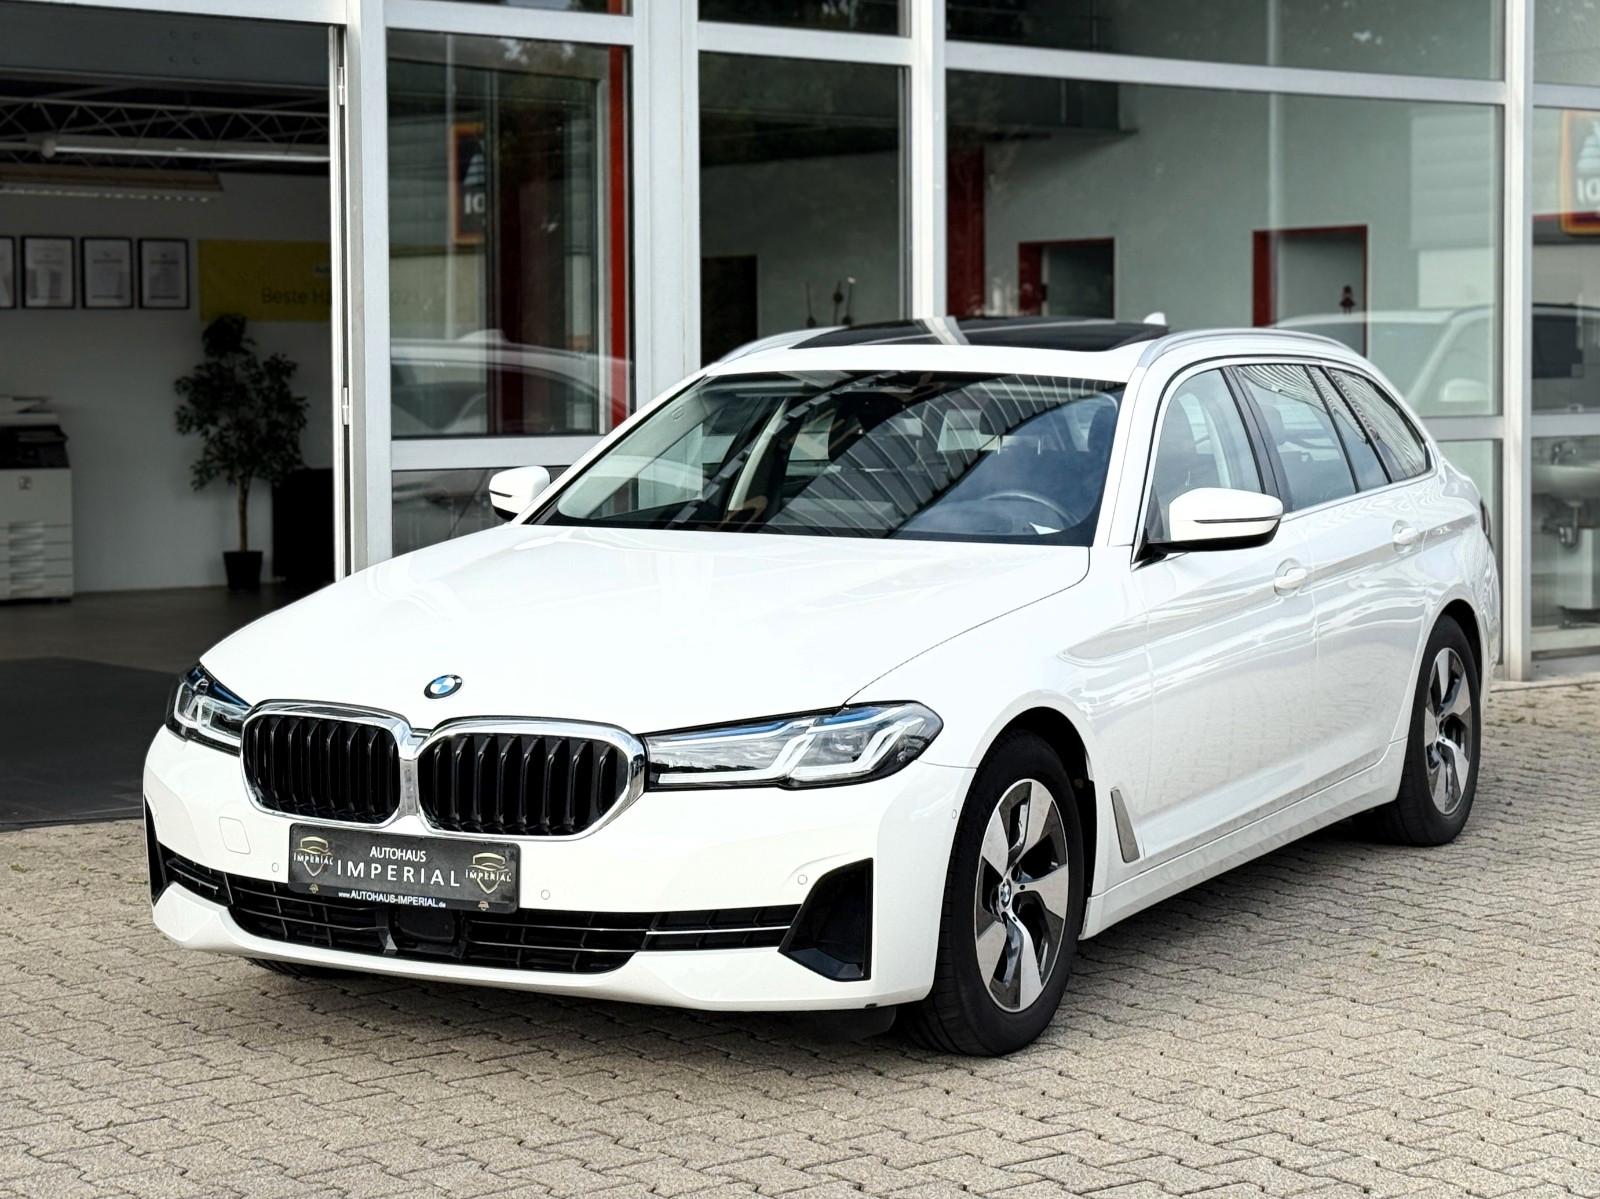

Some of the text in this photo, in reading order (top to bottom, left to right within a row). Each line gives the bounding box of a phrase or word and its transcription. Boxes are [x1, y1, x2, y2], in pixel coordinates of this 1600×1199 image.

[262, 287, 306, 304] Beste
[293, 853, 334, 866] IMPERIAL
[370, 846, 426, 862] AUTOHAUS
[337, 859, 460, 887] IMPERIAL
[465, 869, 512, 882] IMPERIAL
[338, 890, 446, 908] www.AUTOHAUS-IMPERIAL.de
